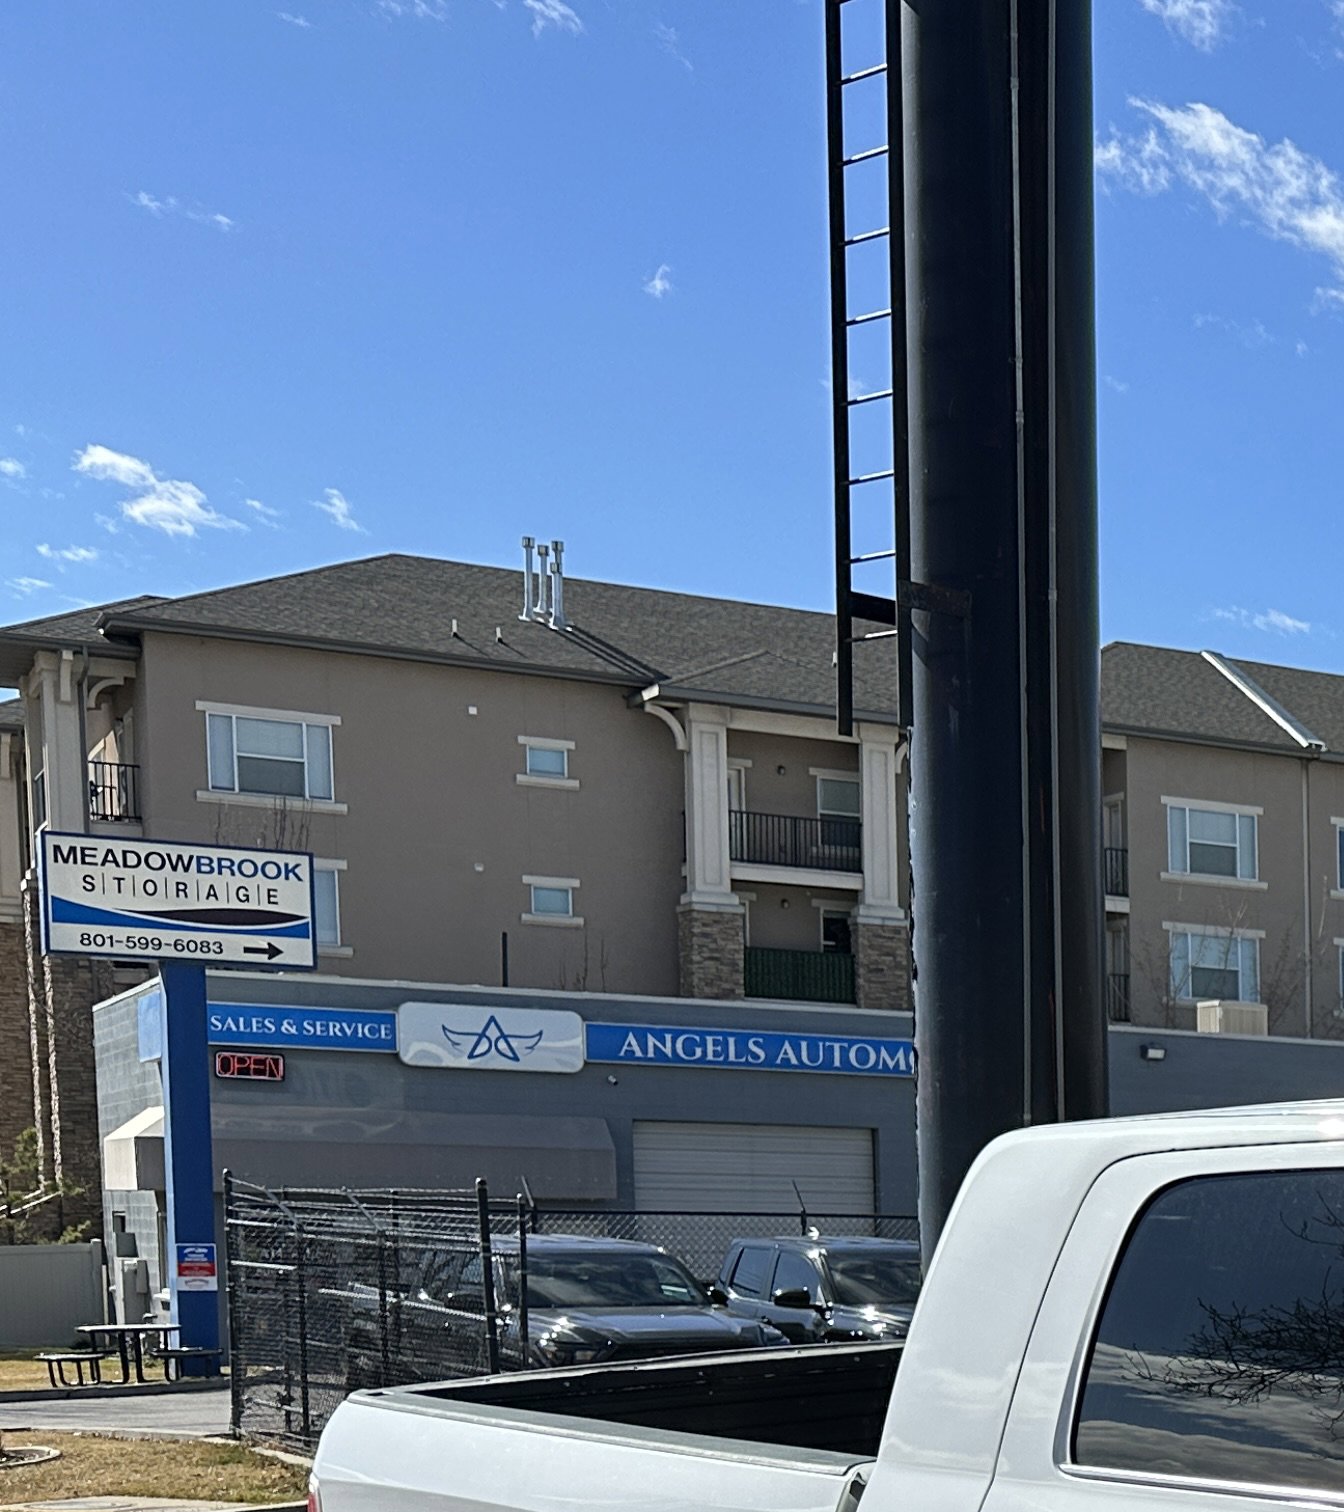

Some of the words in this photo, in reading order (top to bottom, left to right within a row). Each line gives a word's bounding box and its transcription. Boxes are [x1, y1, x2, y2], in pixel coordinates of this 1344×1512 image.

[52, 844, 304, 882] MEADOWBROOK
[79, 933, 224, 955] 801-599-6083
[210, 1015, 275, 1034] SALES
[280, 1019, 298, 1036] &
[303, 1020, 392, 1040] SERVICE
[618, 1031, 765, 1064] ANGELS
[775, 1040, 914, 1072] AUTOM
[218, 1054, 282, 1079] OPEN
